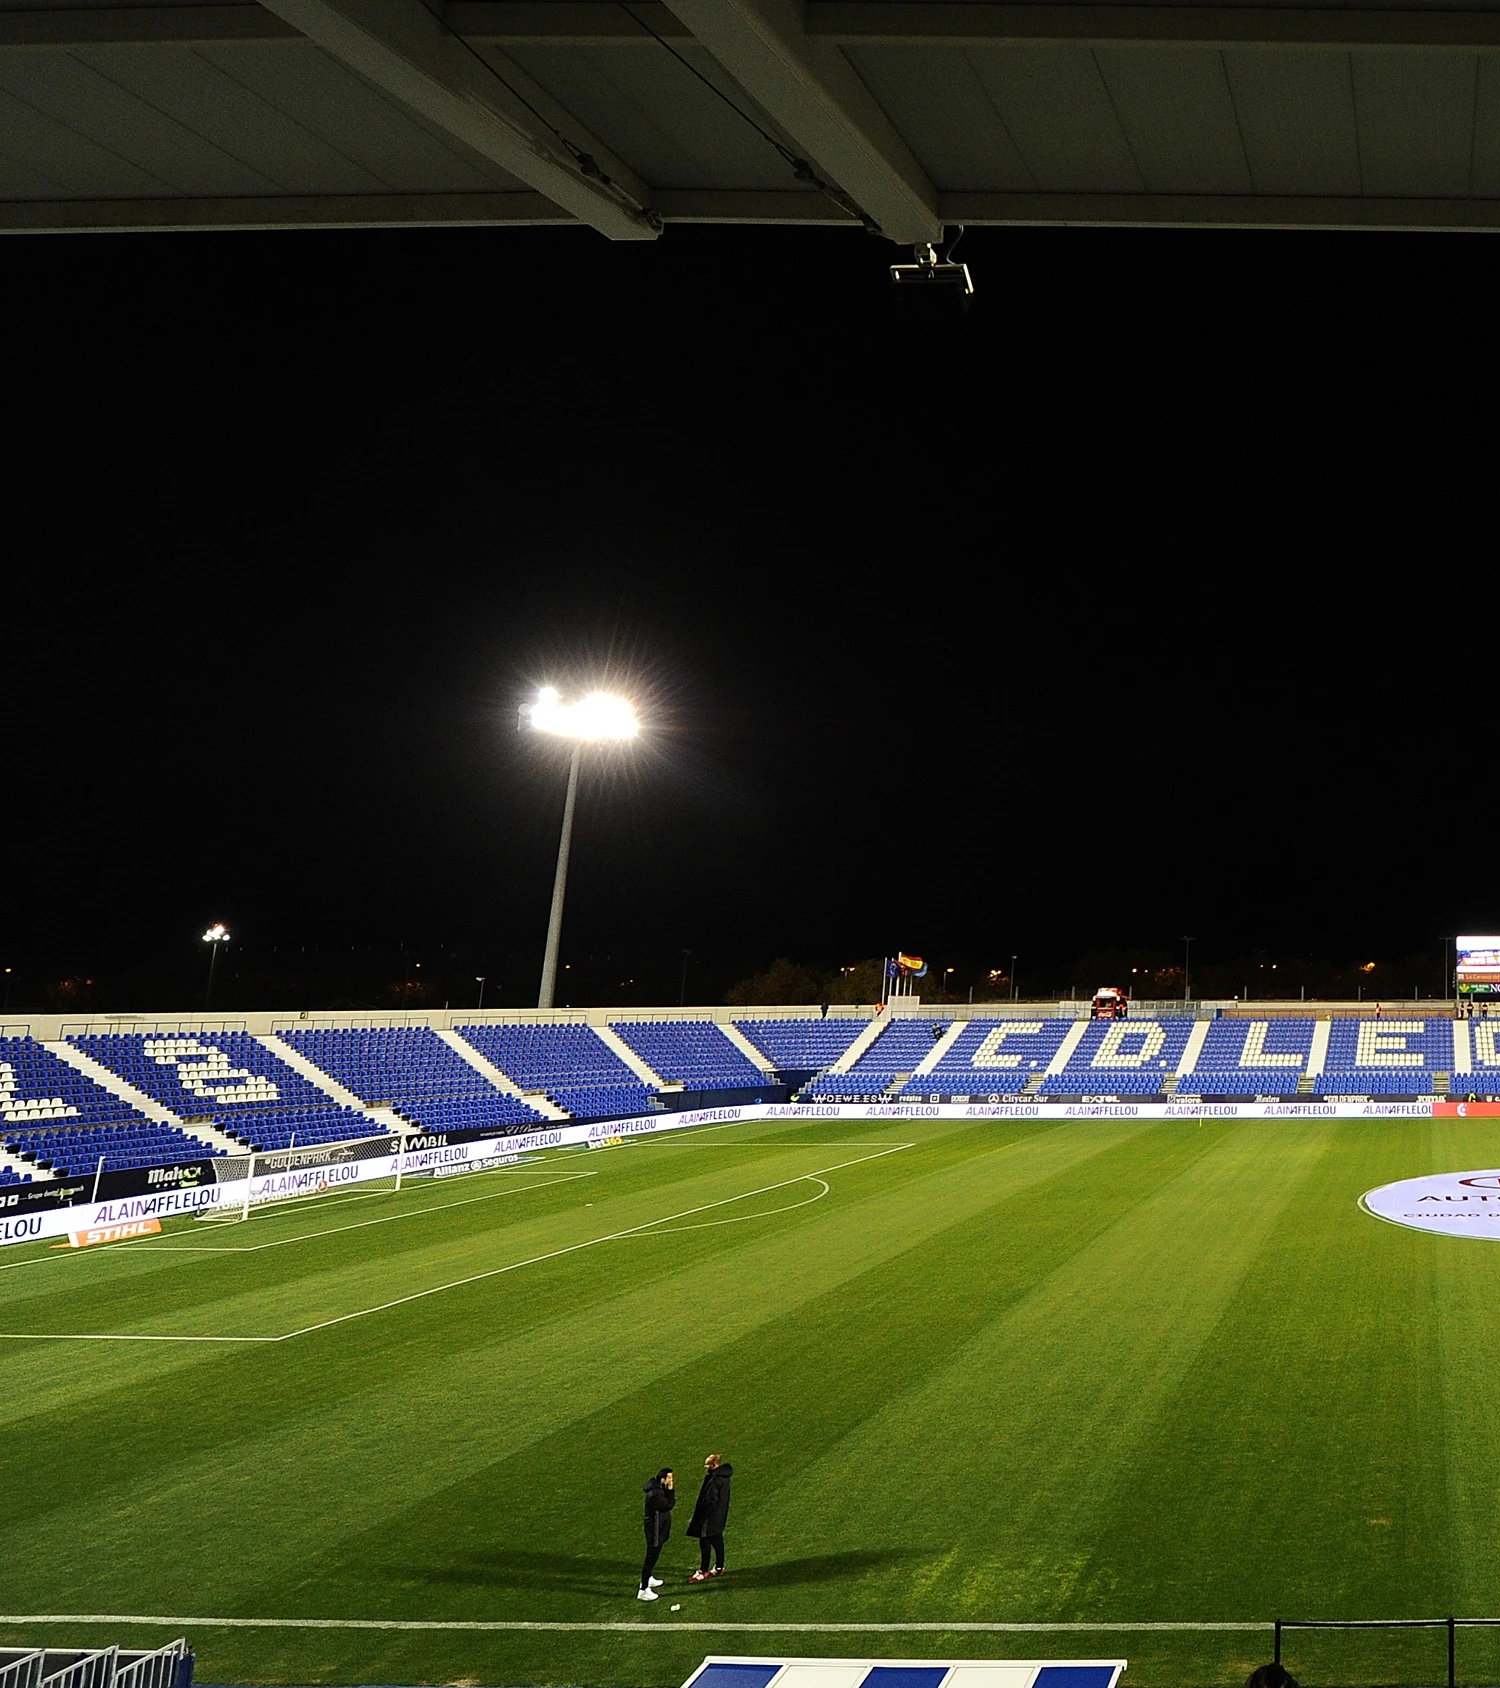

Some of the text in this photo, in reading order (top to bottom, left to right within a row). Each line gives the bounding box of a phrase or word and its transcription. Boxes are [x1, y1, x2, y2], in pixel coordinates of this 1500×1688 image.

[588, 1136, 623, 1150] bet365
[147, 1165, 202, 1184] Mah
[433, 1153, 518, 1178] Allianz Seguros
[86, 1222, 153, 1244] STIHL
